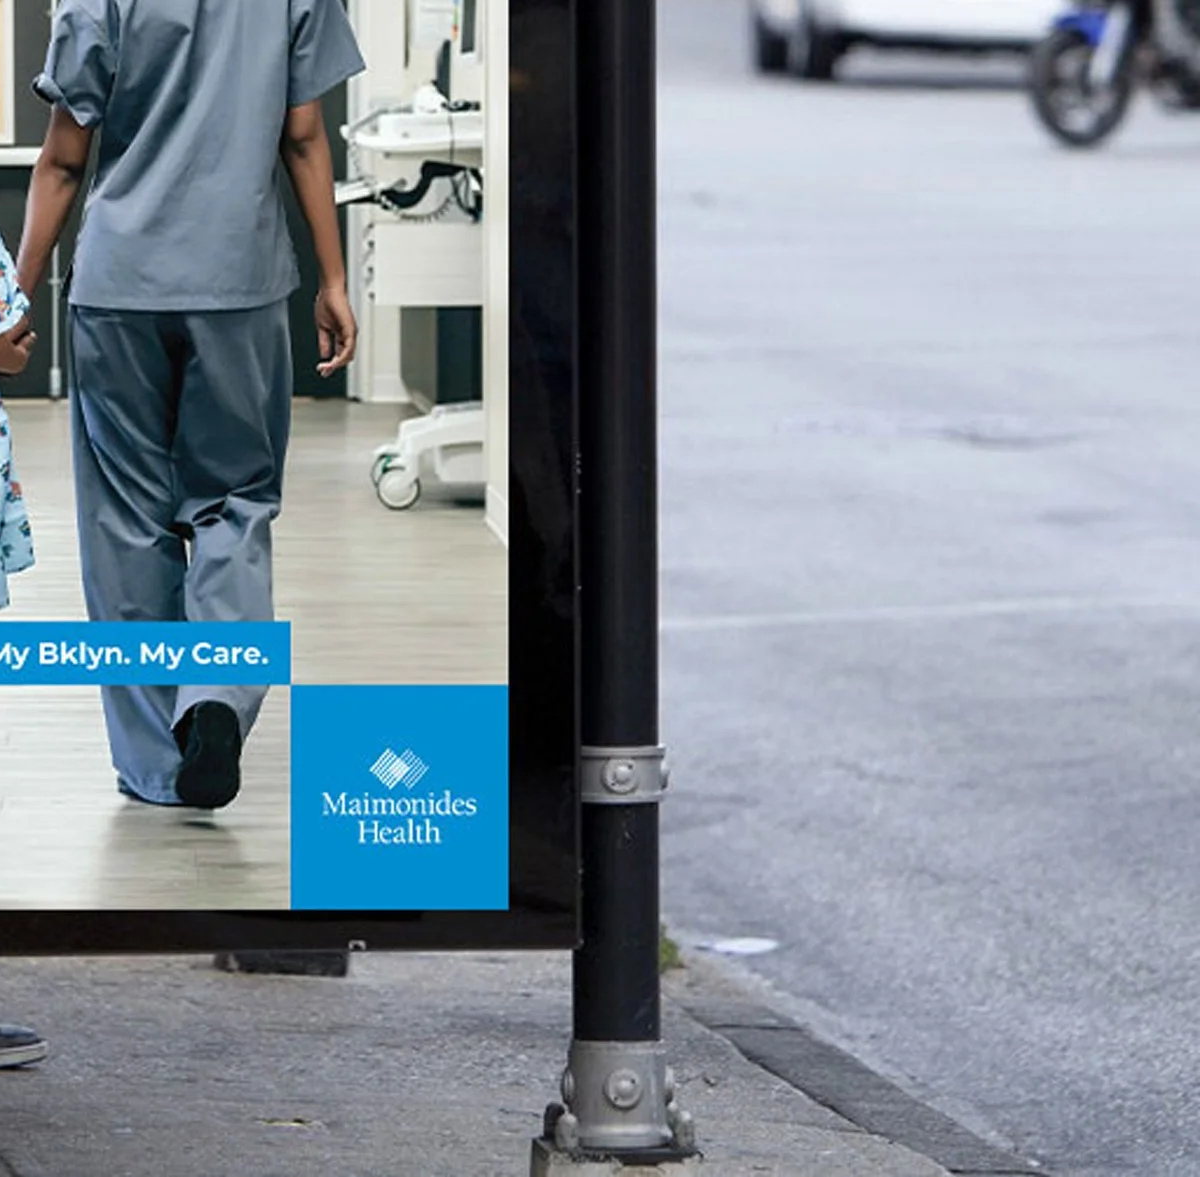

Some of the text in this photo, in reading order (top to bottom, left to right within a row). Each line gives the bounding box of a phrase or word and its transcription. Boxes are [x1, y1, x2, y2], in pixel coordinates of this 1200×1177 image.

[38, 641, 132, 671] Bklyn.
[139, 641, 186, 671] My
[191, 641, 269, 665] Care.
[321, 789, 478, 817] Maimonides
[358, 818, 443, 845] Health
